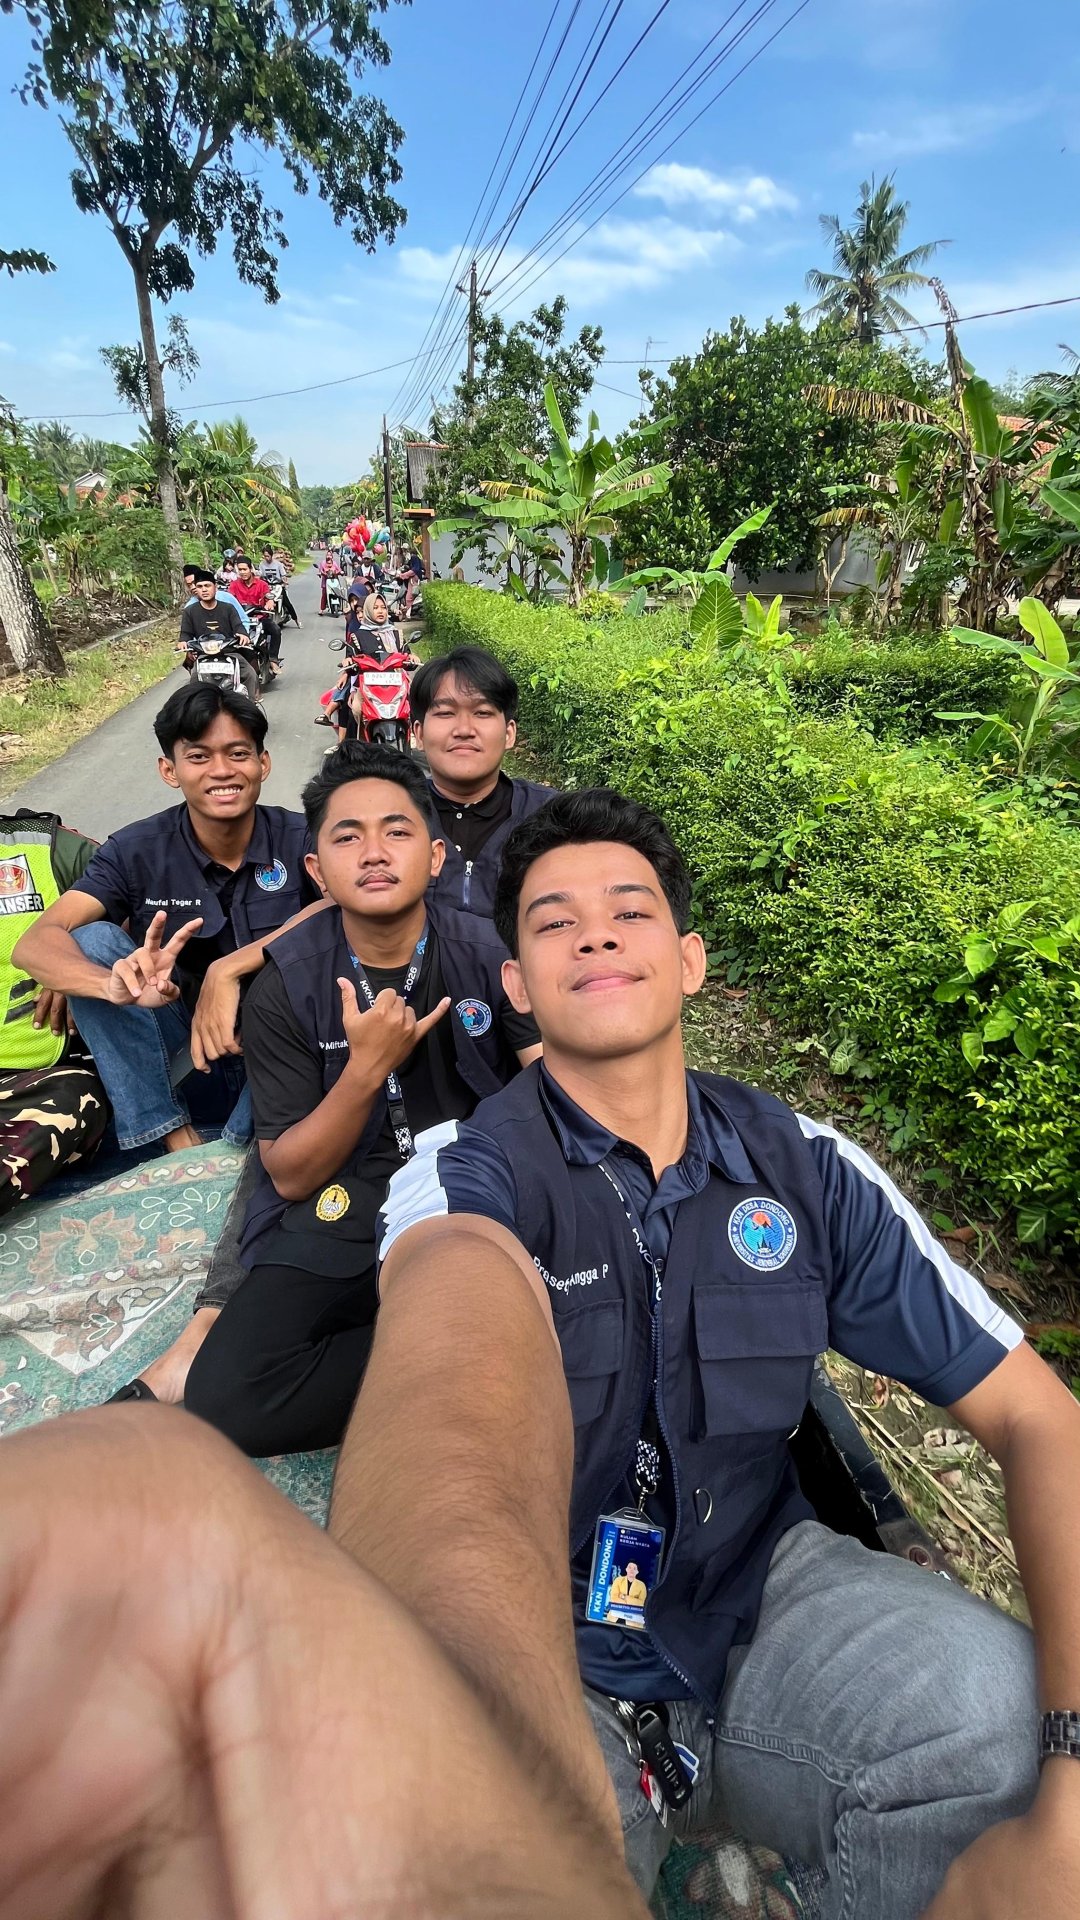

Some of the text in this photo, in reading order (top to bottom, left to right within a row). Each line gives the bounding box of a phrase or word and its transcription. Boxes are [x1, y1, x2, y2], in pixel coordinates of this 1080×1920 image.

[171, 899, 193, 907] Tegar
[360, 979, 375, 1000] KKN
[404, 966, 418, 992] 2026
[733, 1201, 790, 1226] KKN DESA DONDONG
[570, 1268, 599, 1286] Angga
[602, 1263, 609, 1279] P
[598, 1538, 614, 1585] DONDONG
[593, 1591, 604, 1613] KKN
